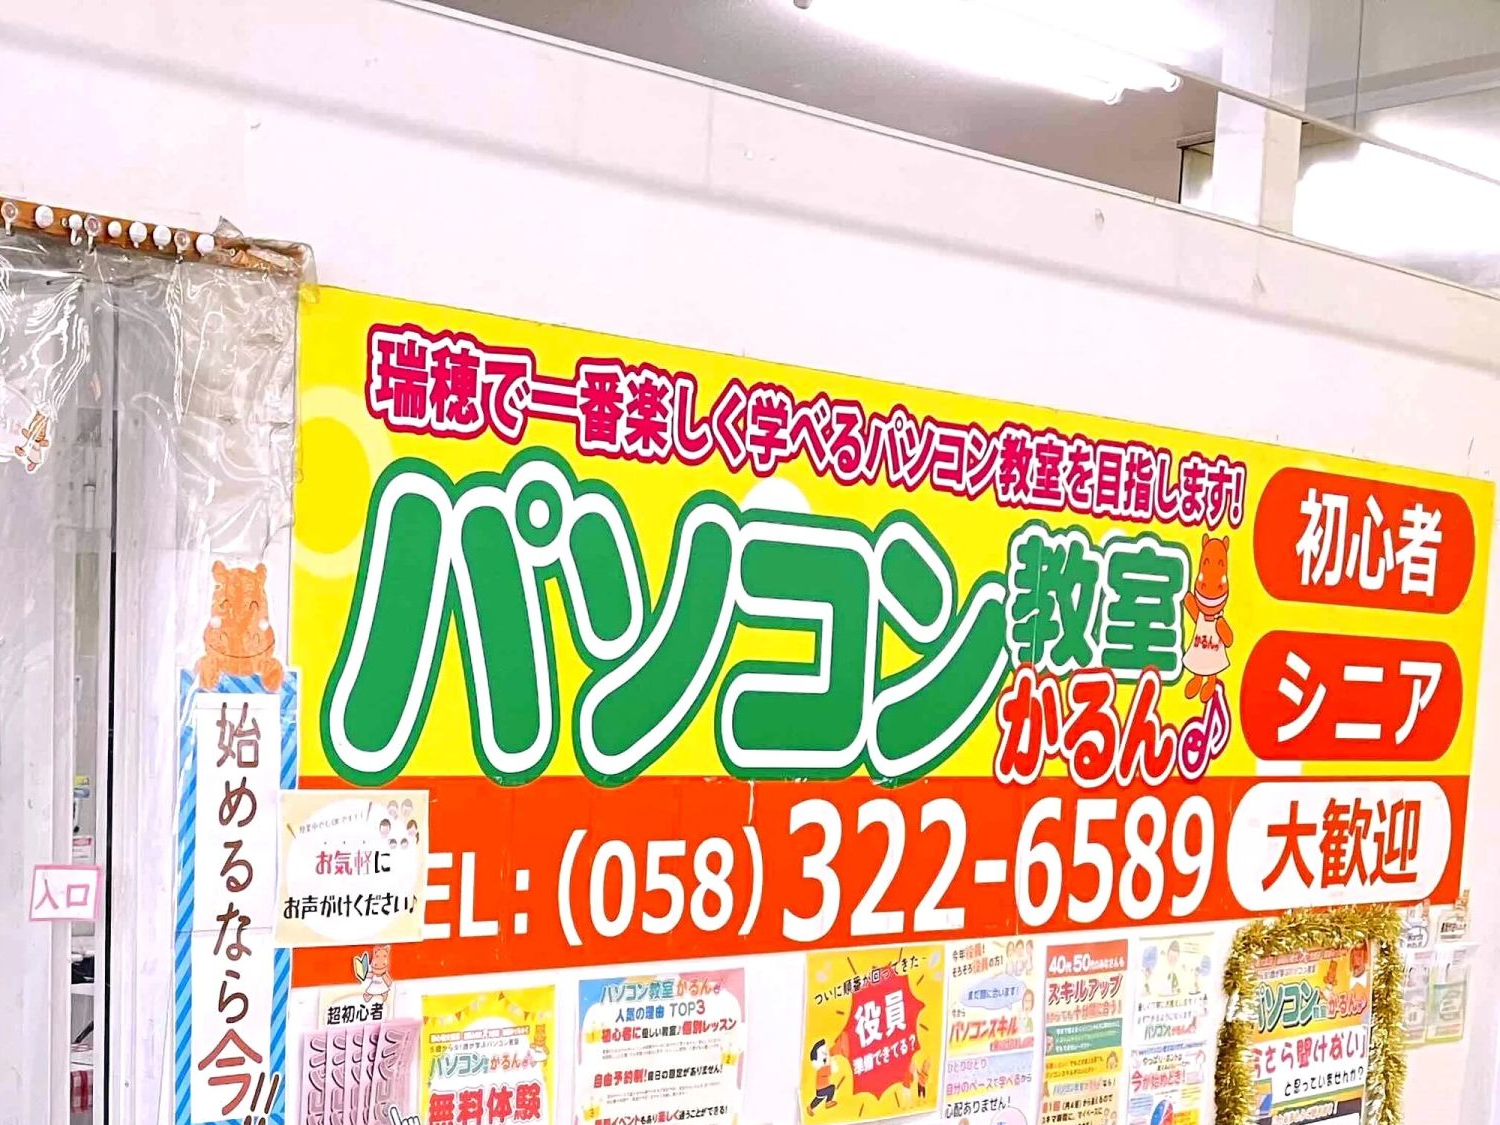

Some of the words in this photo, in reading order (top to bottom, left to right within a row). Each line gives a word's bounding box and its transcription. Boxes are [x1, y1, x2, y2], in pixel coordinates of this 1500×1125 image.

[1296, 487, 1443, 597] 初心者
[1276, 650, 1443, 745] シニア
[994, 662, 1178, 788] かるん
[315, 850, 391, 876] お気軽に
[1262, 797, 1422, 892] 大歓迎
[34, 878, 91, 911] 入口
[615, 1006, 665, 1023] 人気の理由
[669, 999, 706, 1018] TOP3
[1048, 975, 1123, 1006] スキルアップ
[327, 1003, 384, 1025] 超初心者
[854, 989, 907, 1049] 役員
